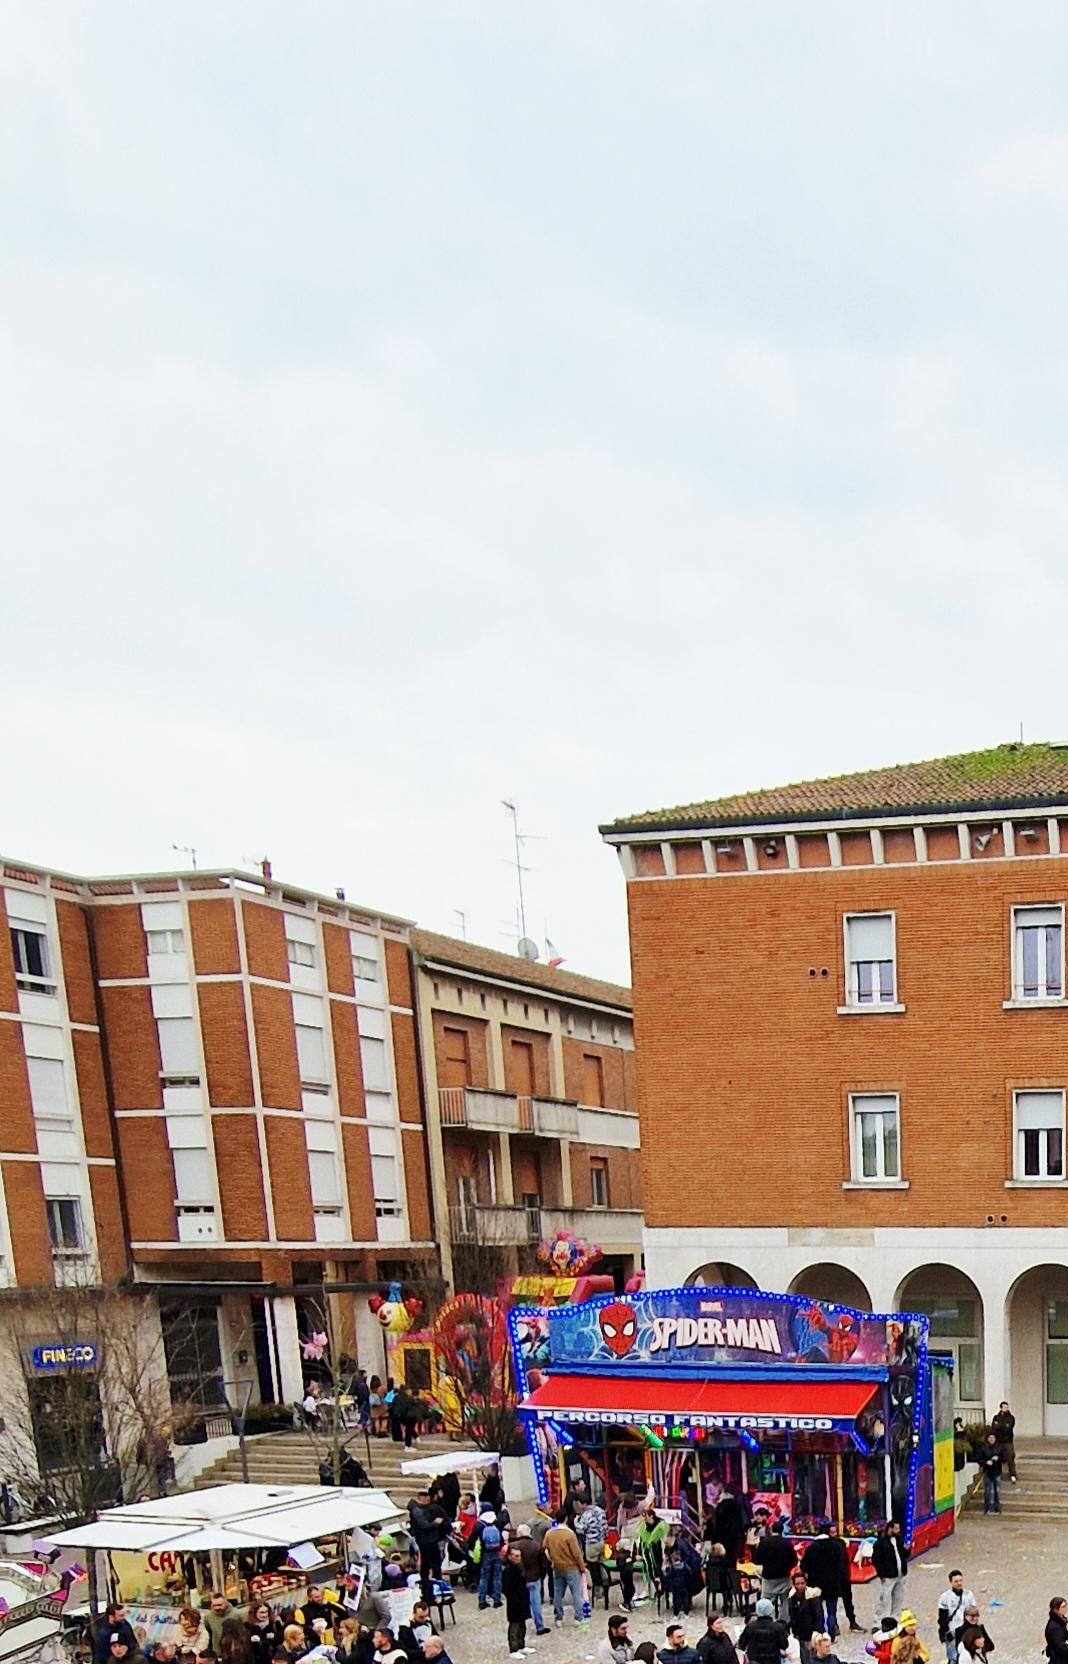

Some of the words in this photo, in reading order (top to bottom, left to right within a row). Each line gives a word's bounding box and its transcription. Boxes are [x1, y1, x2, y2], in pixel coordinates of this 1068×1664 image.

[650, 1317, 782, 1354] SPIDER-MAN
[537, 1410, 665, 1424] PERCORSO
[674, 1415, 833, 1429] FANTASTICO
